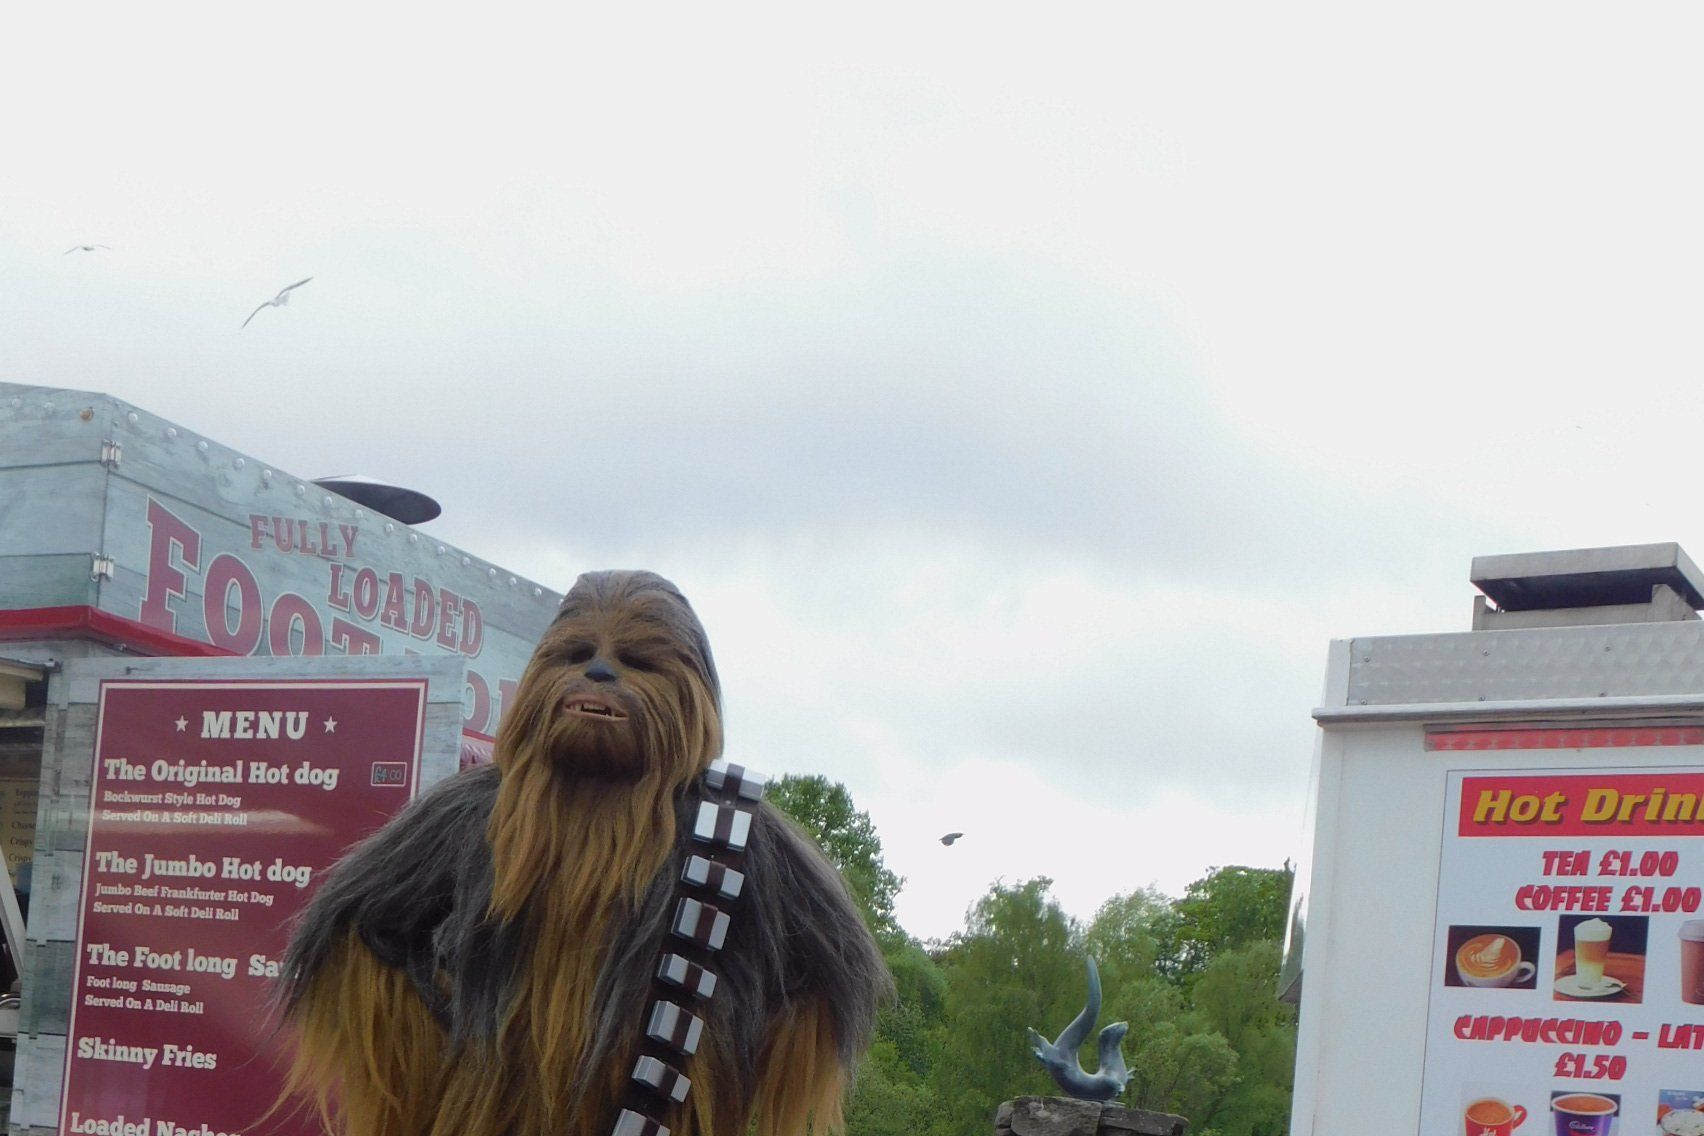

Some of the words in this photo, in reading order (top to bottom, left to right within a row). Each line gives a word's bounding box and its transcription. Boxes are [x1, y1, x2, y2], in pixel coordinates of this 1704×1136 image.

[250, 514, 360, 557] FULLY
[327, 562, 486, 660] LOADED
[201, 711, 309, 740] MENU
[104, 758, 146, 780] The
[152, 760, 244, 786] Original
[249, 762, 290, 784] Hot
[294, 761, 340, 790] dog
[103, 790, 163, 805] Bockwurst
[165, 793, 194, 808] Style
[196, 793, 217, 806] Hot
[218, 794, 242, 808] Dog
[1473, 789, 1568, 823] Hot
[102, 810, 141, 822] Served
[143, 811, 159, 823] On
[162, 812, 171, 823] A
[173, 812, 197, 824] Soft
[199, 812, 222, 825] Deli
[224, 813, 248, 826] Roll
[96, 851, 138, 874] The
[142, 853, 216, 879] Jumbo
[221, 857, 262, 880] Hot
[267, 858, 313, 888] dog
[1542, 850, 1591, 877] TEA
[1597, 849, 1679, 877] £1.00
[95, 883, 131, 897] Jumbo
[134, 885, 159, 897] Beef
[161, 886, 226, 901] Frankfurter
[228, 890, 249, 903] Hot
[250, 891, 274, 906] Dog
[1515, 884, 1614, 911] COFFEE
[1620, 885, 1702, 912] £1.00
[93, 902, 132, 914] Served
[135, 903, 150, 915] On
[153, 905, 162, 916] A
[164, 906, 189, 917] Soft
[191, 907, 213, 919] Deli
[215, 908, 239, 920] Roll
[87, 943, 129, 966] The
[133, 946, 181, 971] Foot
[186, 948, 238, 979] long
[248, 954, 284, 977] Sa
[86, 975, 110, 989] Foot
[112, 976, 137, 993] long
[141, 979, 191, 996] Sausage
[84, 994, 124, 1008] Served
[126, 996, 141, 1010] On
[144, 998, 153, 1010] A
[156, 999, 178, 1012] Deli
[180, 1001, 204, 1014] Roll
[1453, 1015, 1623, 1046] CAPPUCCINO
[77, 1036, 158, 1069] Skinny
[162, 1044, 217, 1070] Fries
[1553, 1051, 1627, 1080] £1.50
